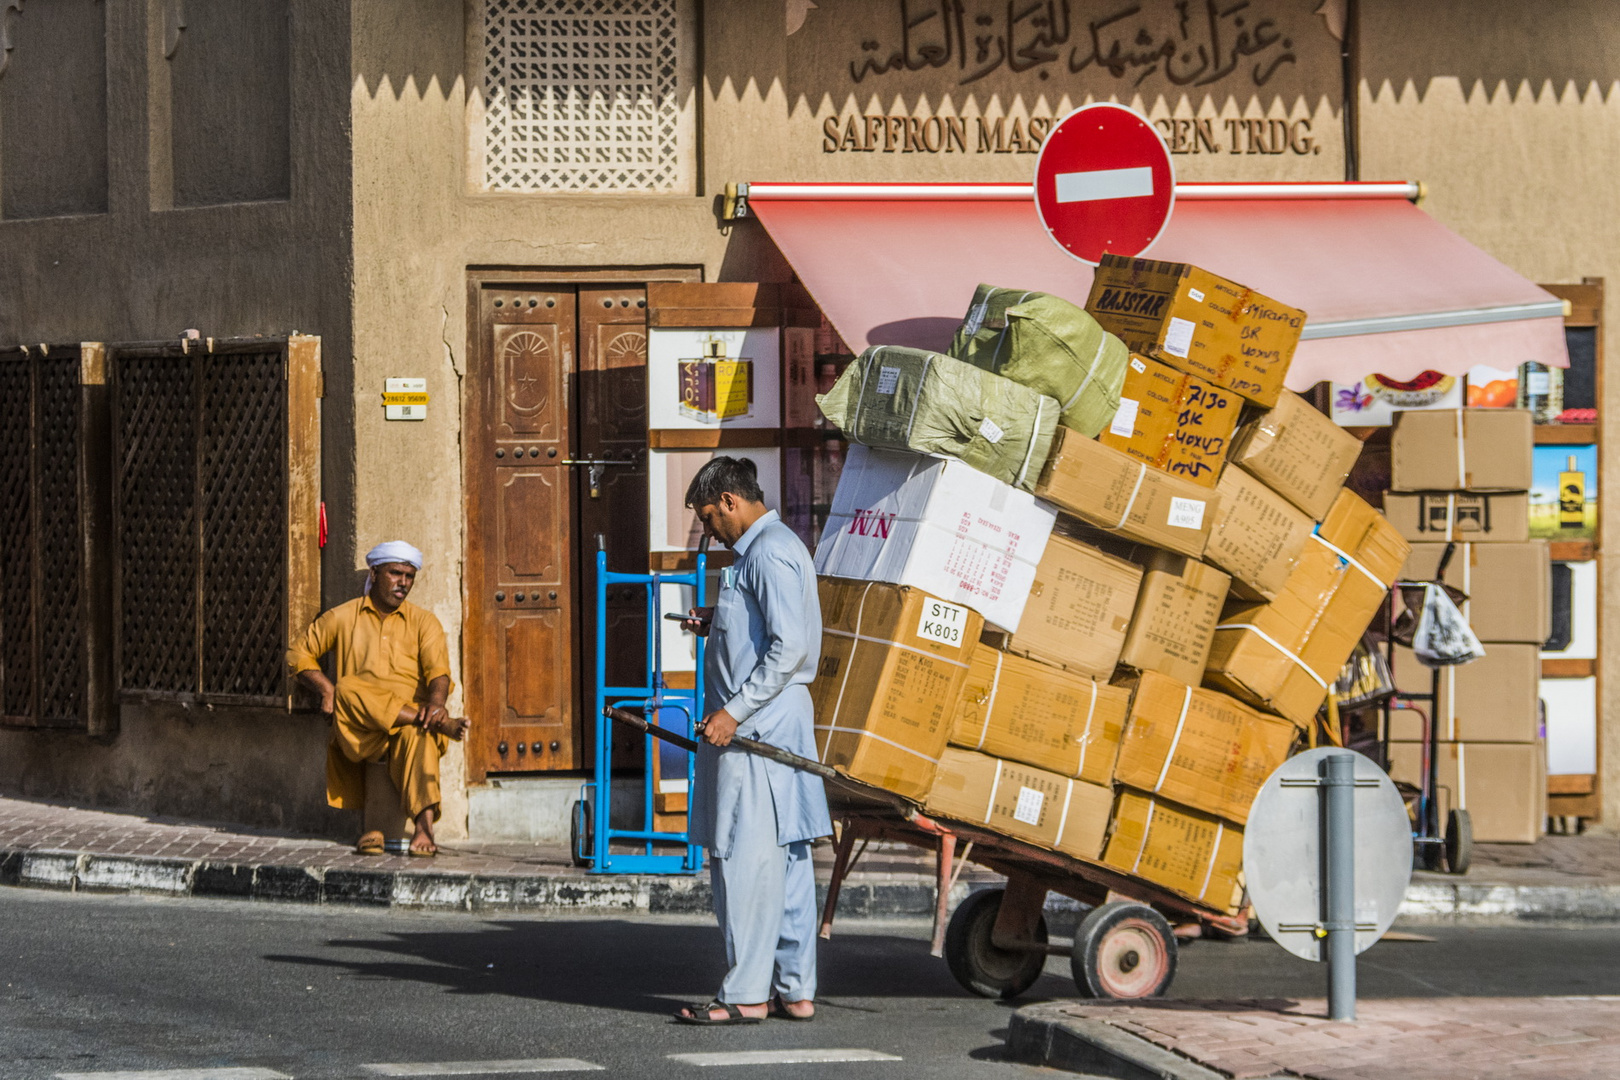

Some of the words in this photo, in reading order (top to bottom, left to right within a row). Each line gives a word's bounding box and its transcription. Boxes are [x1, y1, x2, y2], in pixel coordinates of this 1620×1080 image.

[822, 114, 968, 154] SAFFRON
[1225, 117, 1321, 155] TRDG.
[1214, 284, 1239, 297] ARTICLE
[1096, 288, 1166, 317] RAJSTAR
[1208, 302, 1232, 316] COLOUR
[717, 364, 746, 377] ROJA
[1153, 372, 1175, 385] ARTICLE
[1147, 390, 1169, 403] COLOUR
[1186, 385, 1227, 409] 7130
[1177, 409, 1203, 427] BK
[931, 603, 960, 621] STT
[923, 620, 959, 641] K803
